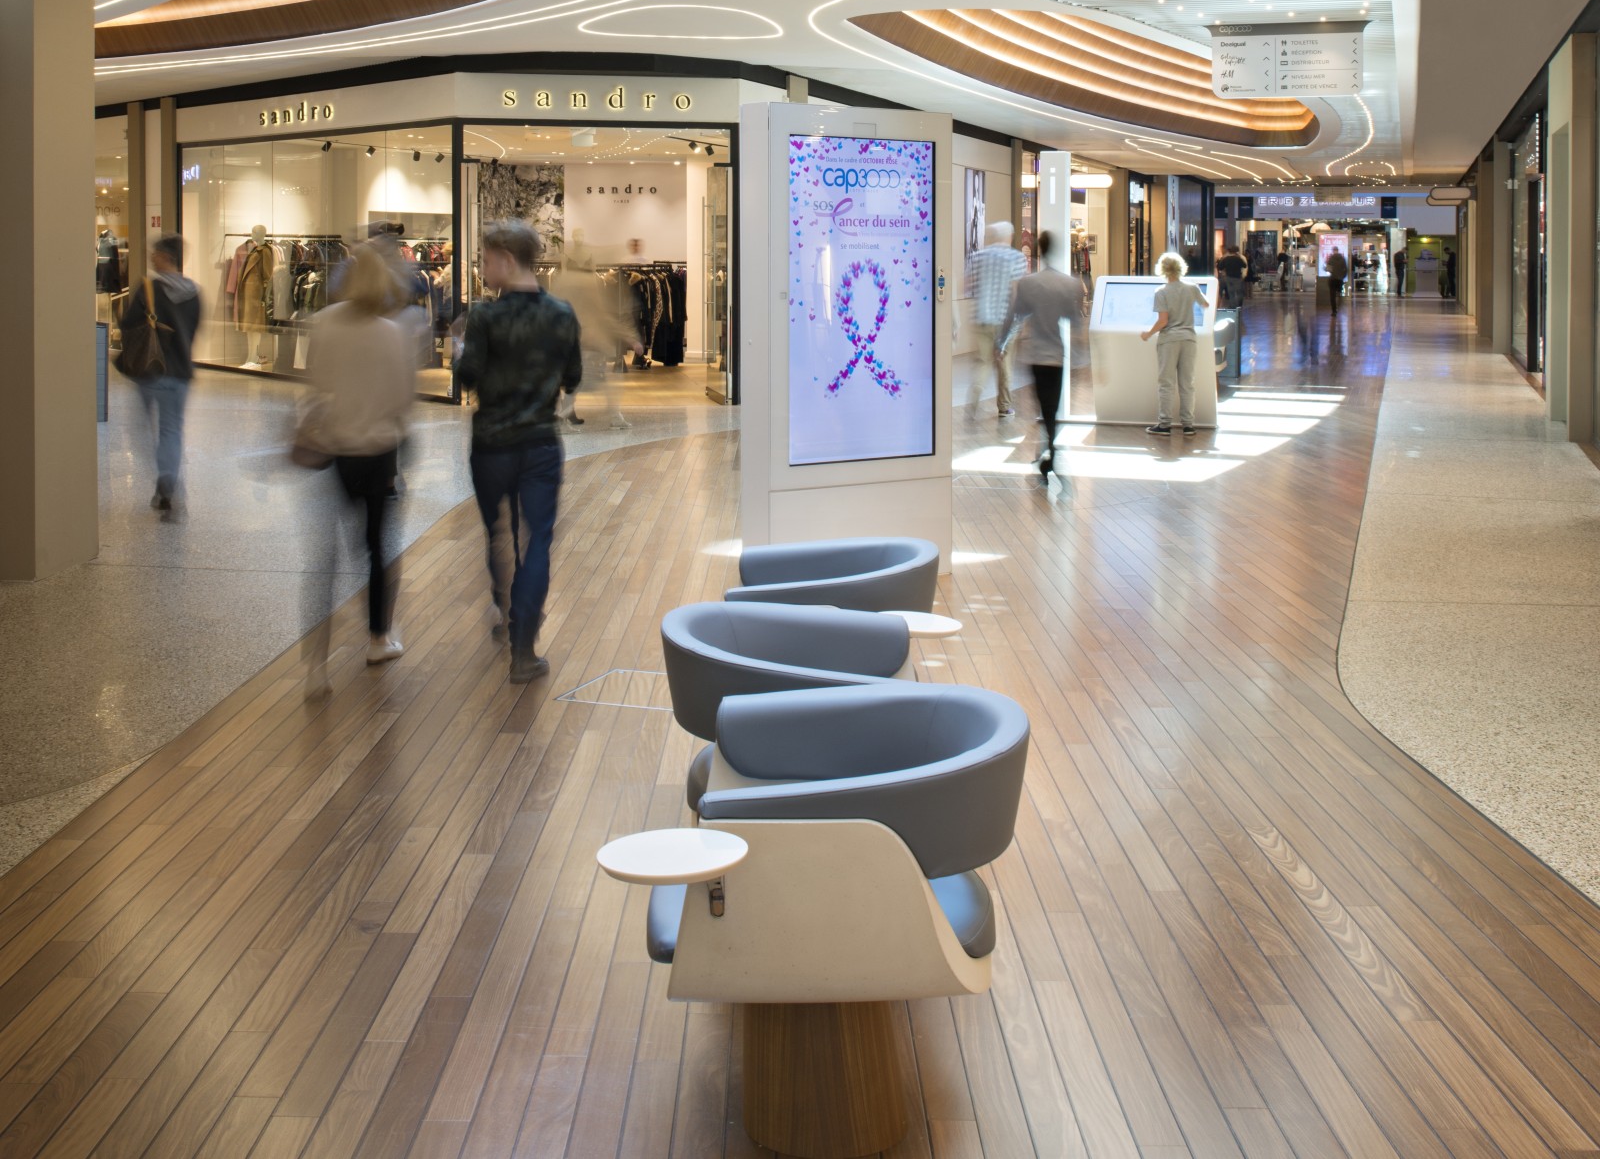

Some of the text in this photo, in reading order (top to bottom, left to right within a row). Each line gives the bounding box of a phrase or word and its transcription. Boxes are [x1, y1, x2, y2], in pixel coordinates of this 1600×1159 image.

[503, 87, 692, 110] sandro
[258, 101, 333, 126] sandro
[586, 184, 657, 194] sandro
[822, 167, 901, 194] cap3000
[813, 200, 834, 211] SOS
[872, 214, 886, 228] du
[889, 215, 910, 228] sein
[1184, 224, 1198, 246] ALDO
